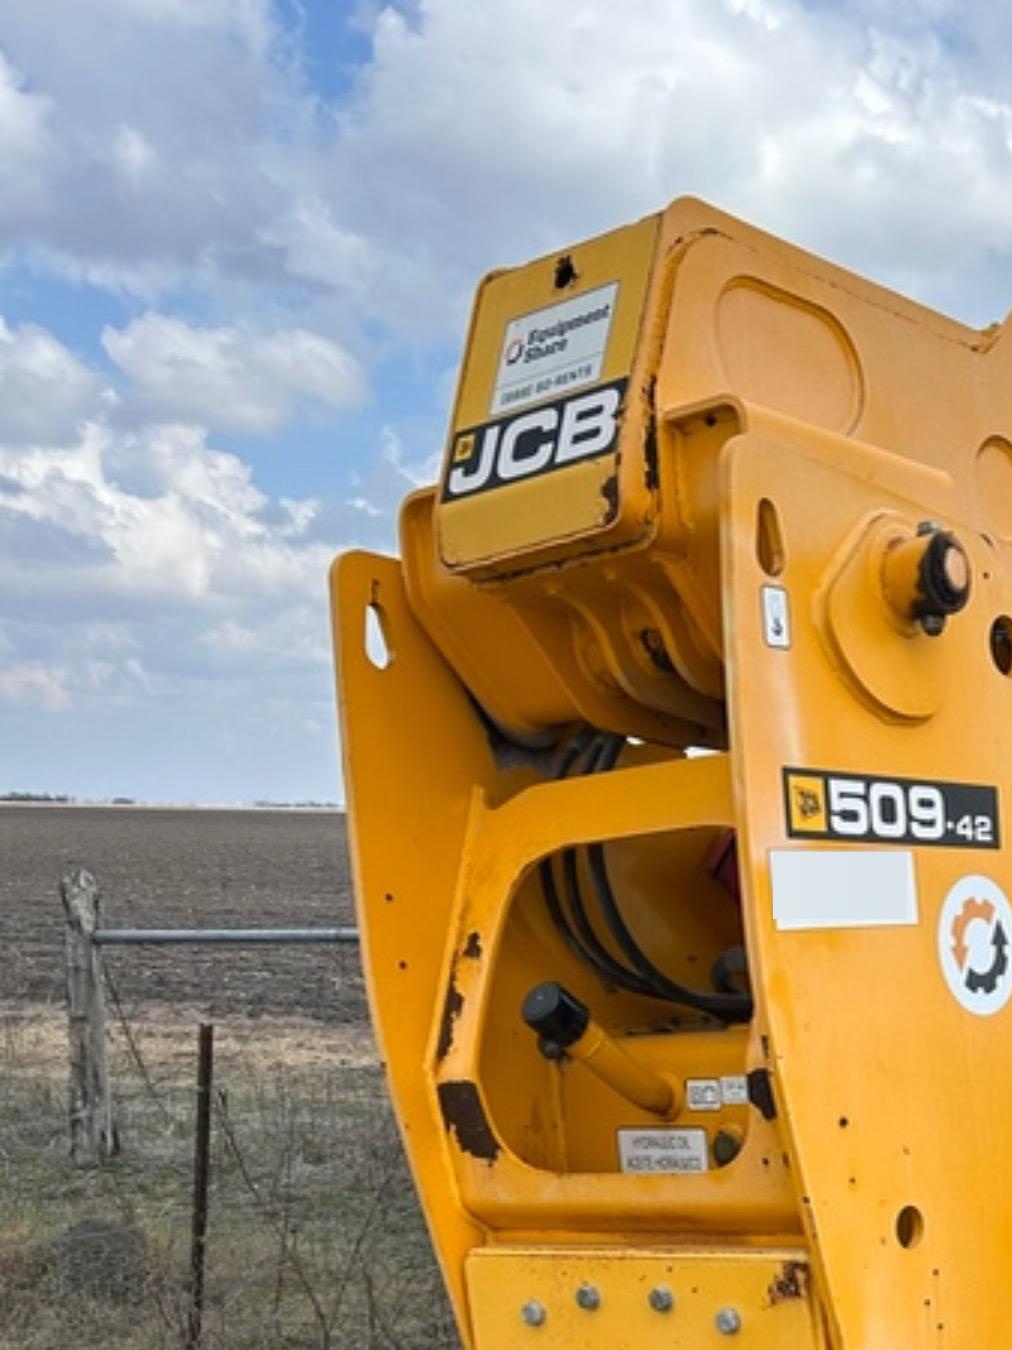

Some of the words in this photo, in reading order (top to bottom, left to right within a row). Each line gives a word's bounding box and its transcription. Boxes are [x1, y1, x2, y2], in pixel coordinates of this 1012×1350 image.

[527, 304, 609, 345] Equipment
[524, 338, 568, 364] Share
[449, 387, 621, 495] JCB
